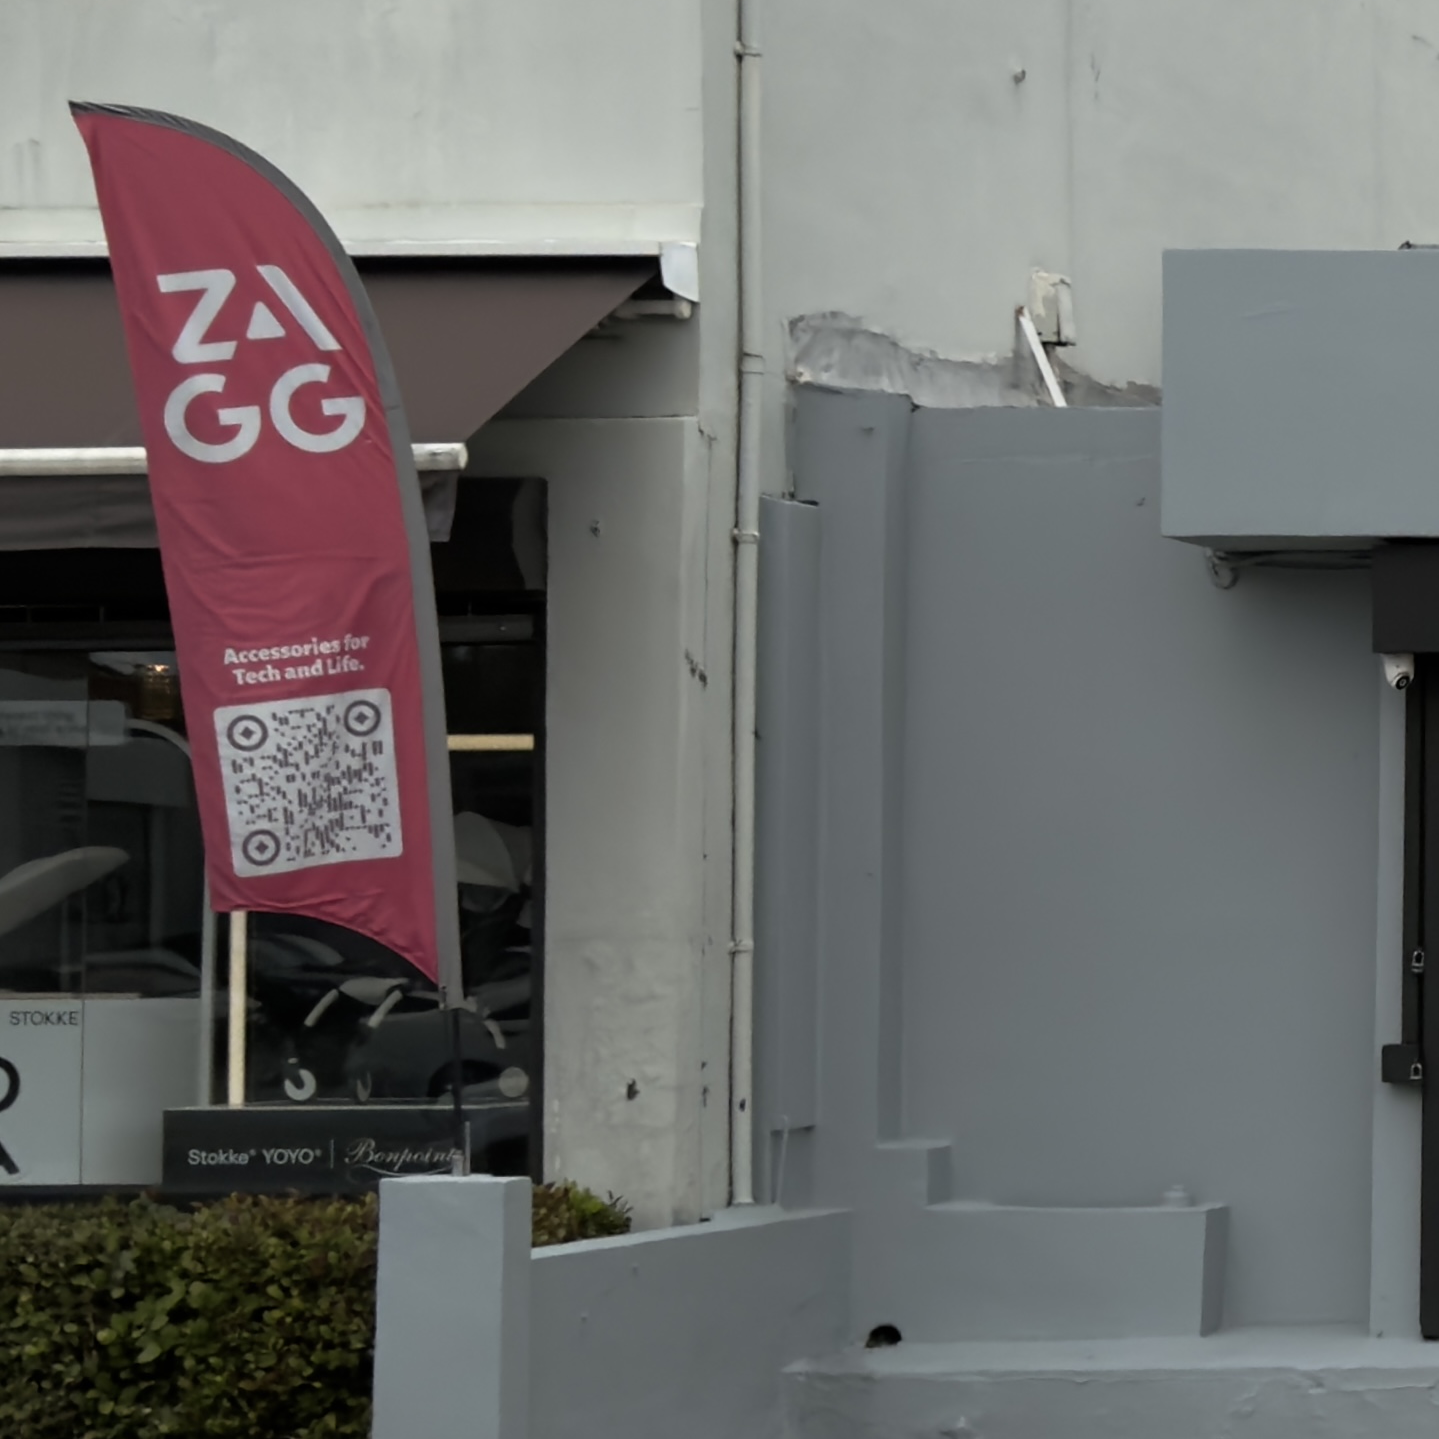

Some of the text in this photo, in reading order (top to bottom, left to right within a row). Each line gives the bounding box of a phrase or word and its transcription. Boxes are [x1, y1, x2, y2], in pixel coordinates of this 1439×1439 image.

[163, 364, 366, 464] GG
[223, 632, 370, 666] Accessories for
[232, 655, 366, 687] Tech and Life.
[8, 1010, 80, 1027] STOKKE
